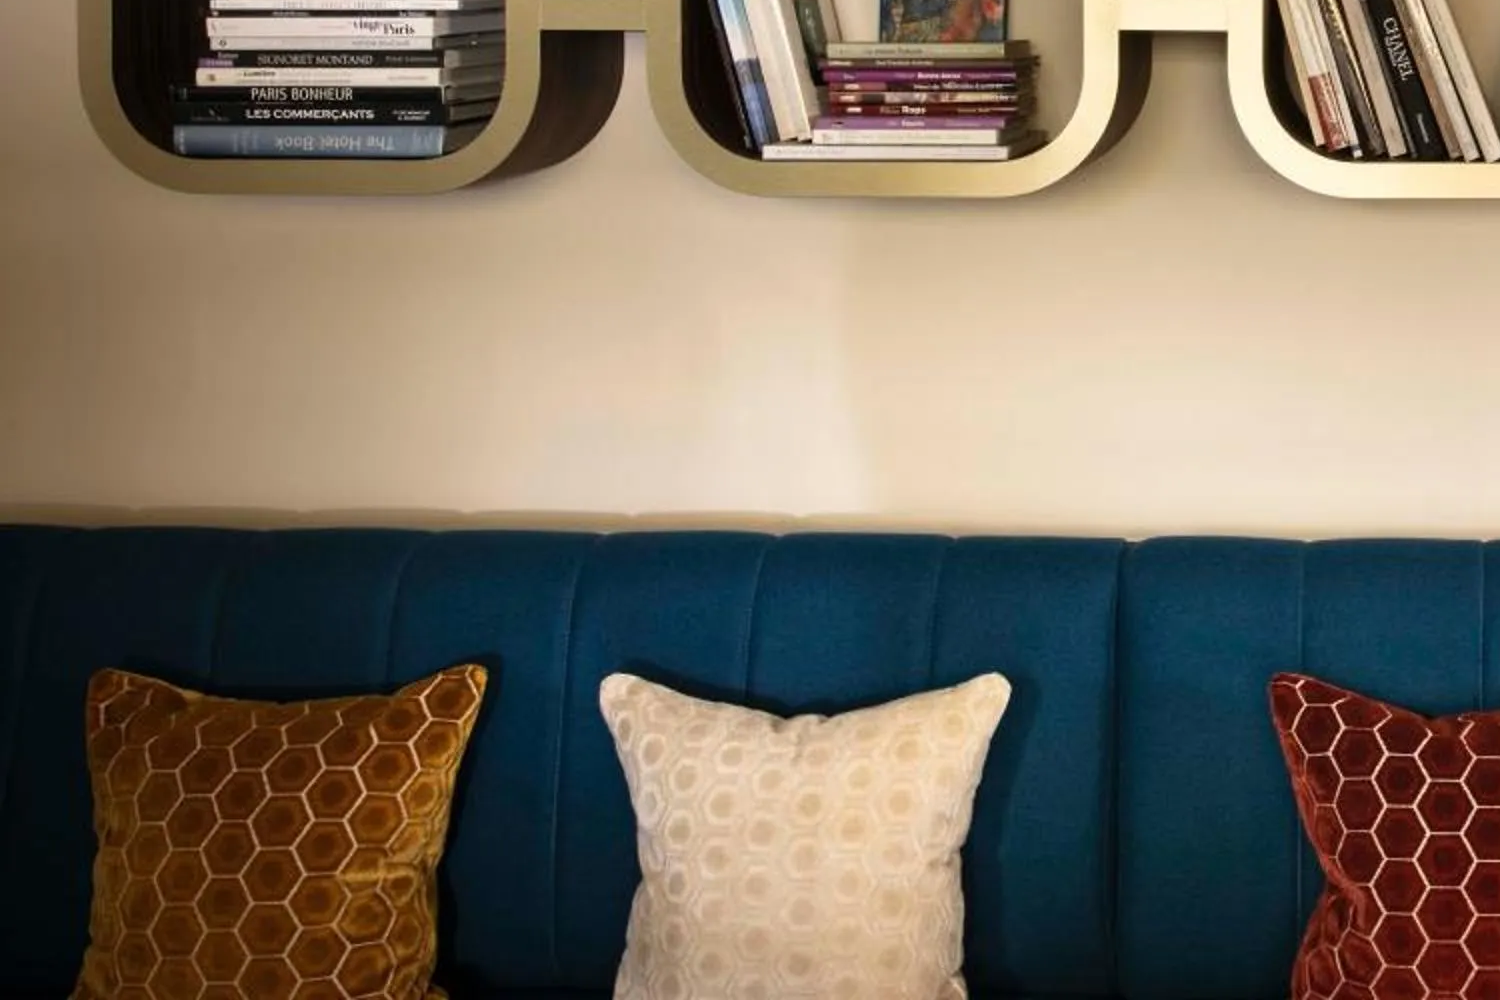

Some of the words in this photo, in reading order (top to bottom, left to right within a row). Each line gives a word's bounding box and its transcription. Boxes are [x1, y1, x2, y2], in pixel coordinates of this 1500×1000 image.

[1382, 17, 1416, 81] CHANEL
[251, 87, 288, 101] PARIS
[291, 87, 353, 101] BONHEUR
[245, 109, 271, 119] LES
[273, 109, 375, 122] COMMERÇANTS
[274, 135, 314, 151] Book
[321, 135, 361, 151] Hotel
[367, 135, 395, 151] The
